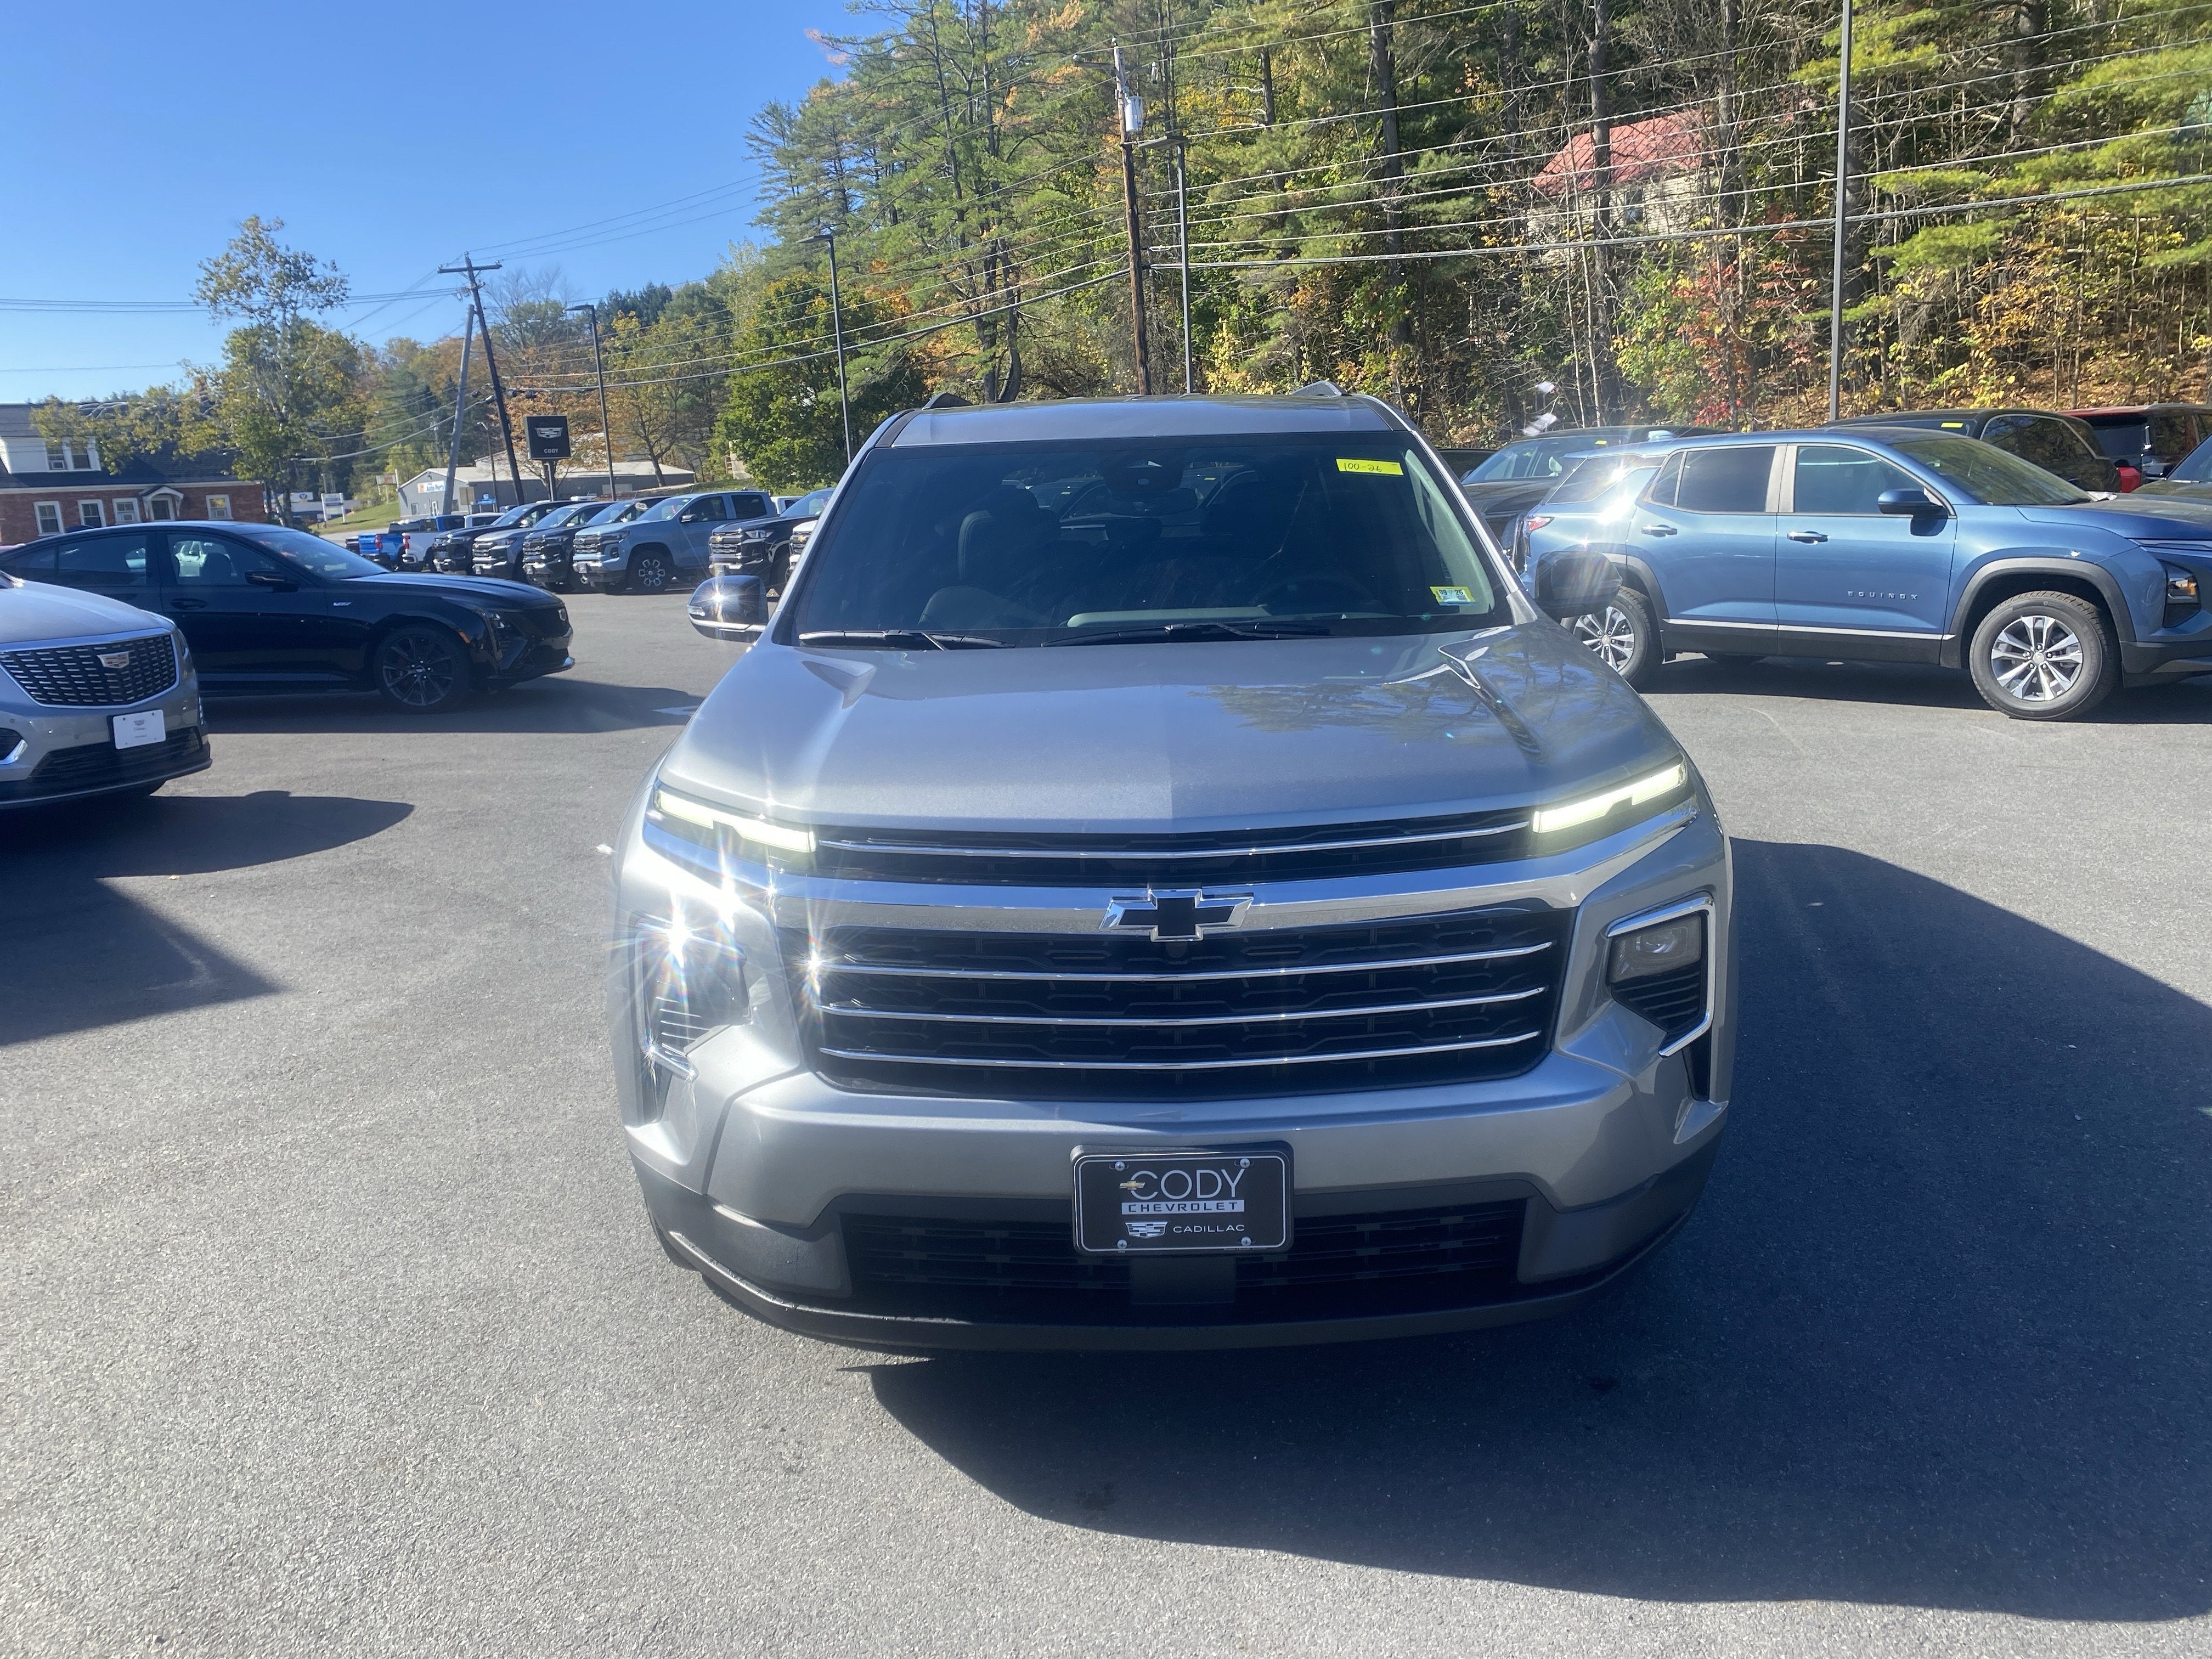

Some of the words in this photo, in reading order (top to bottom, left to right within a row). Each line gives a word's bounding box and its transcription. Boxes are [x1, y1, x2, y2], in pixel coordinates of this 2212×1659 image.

[1848, 591, 1918, 600] EQUINOX
[1130, 1169, 1245, 1200] CODY
[1128, 1202, 1238, 1212] CHEVROLET
[1173, 1224, 1245, 1233] CADILLAC
